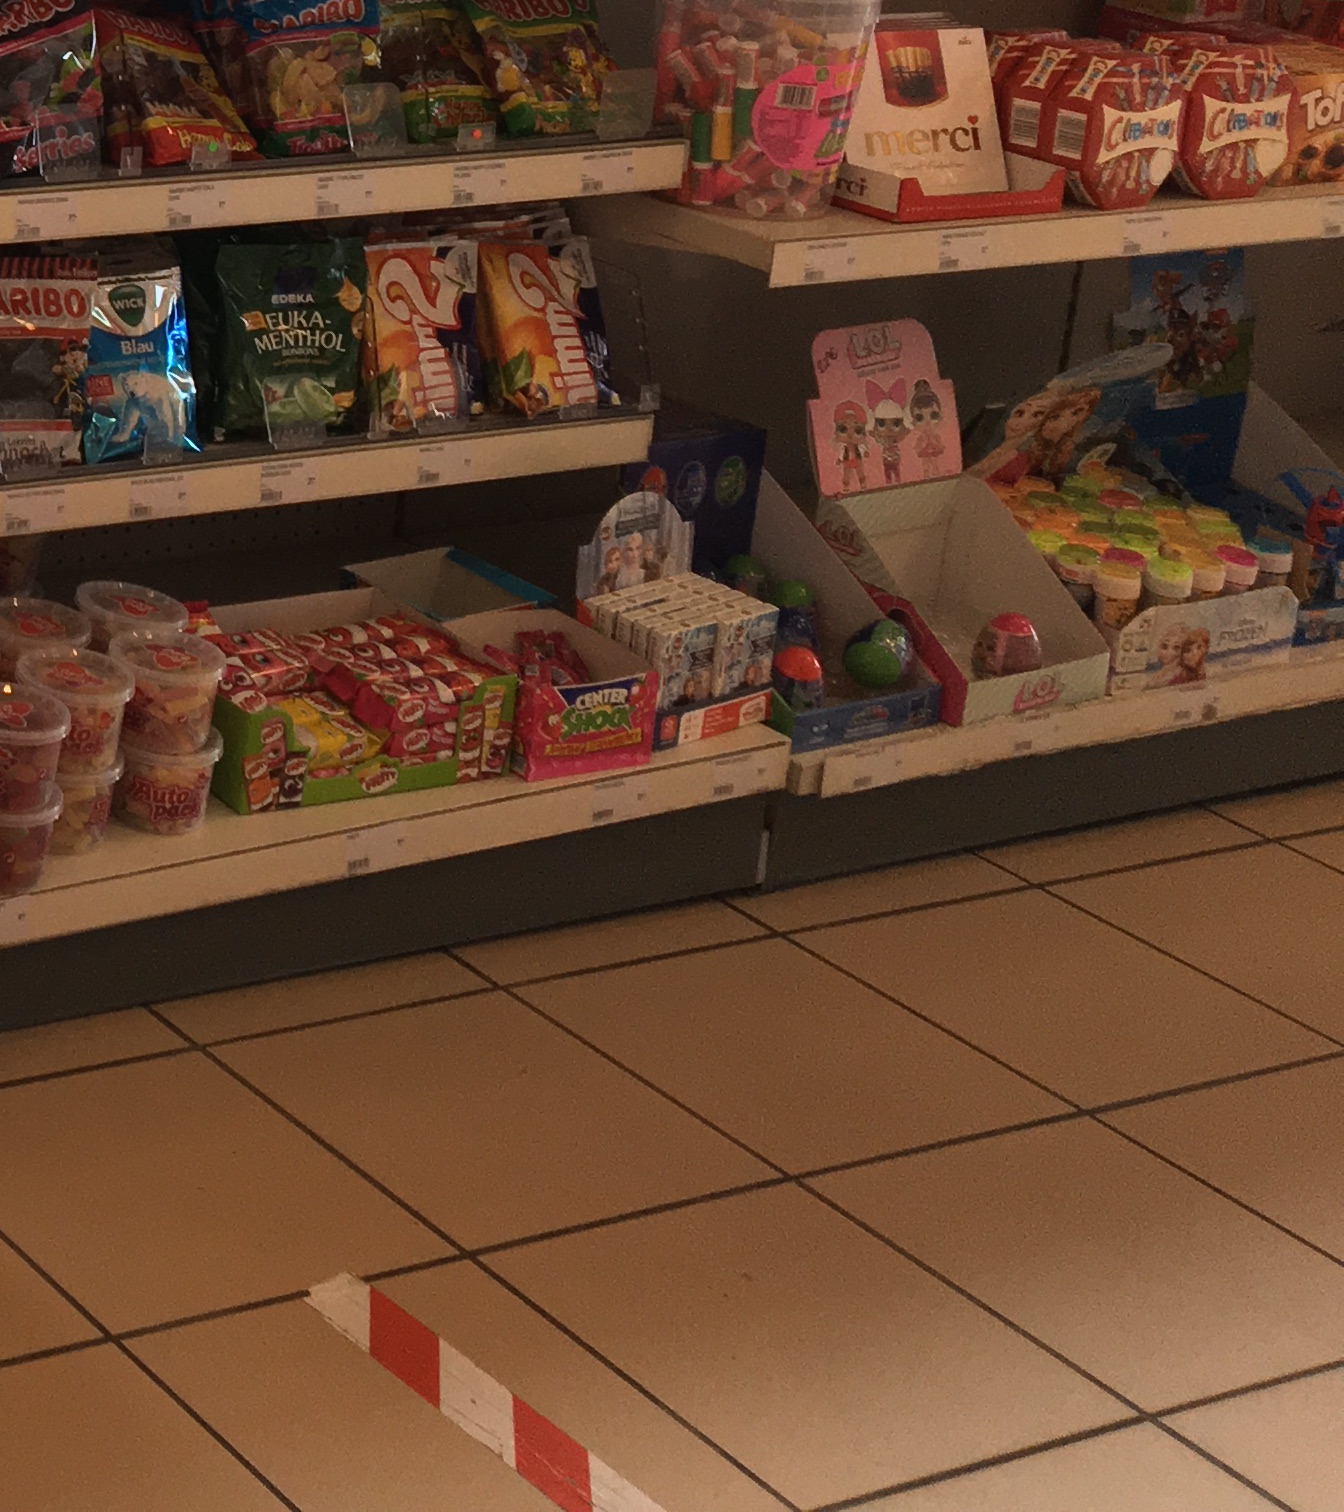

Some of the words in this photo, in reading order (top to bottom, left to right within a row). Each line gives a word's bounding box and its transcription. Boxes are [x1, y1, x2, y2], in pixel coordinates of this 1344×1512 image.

[864, 114, 983, 157] merci
[113, 296, 145, 311] WICK
[271, 293, 315, 305] EDEKA
[267, 309, 332, 330] EUKA-
[121, 339, 155, 355] Blau
[254, 328, 347, 353] MENTHOL
[575, 688, 629, 711] CENTER
